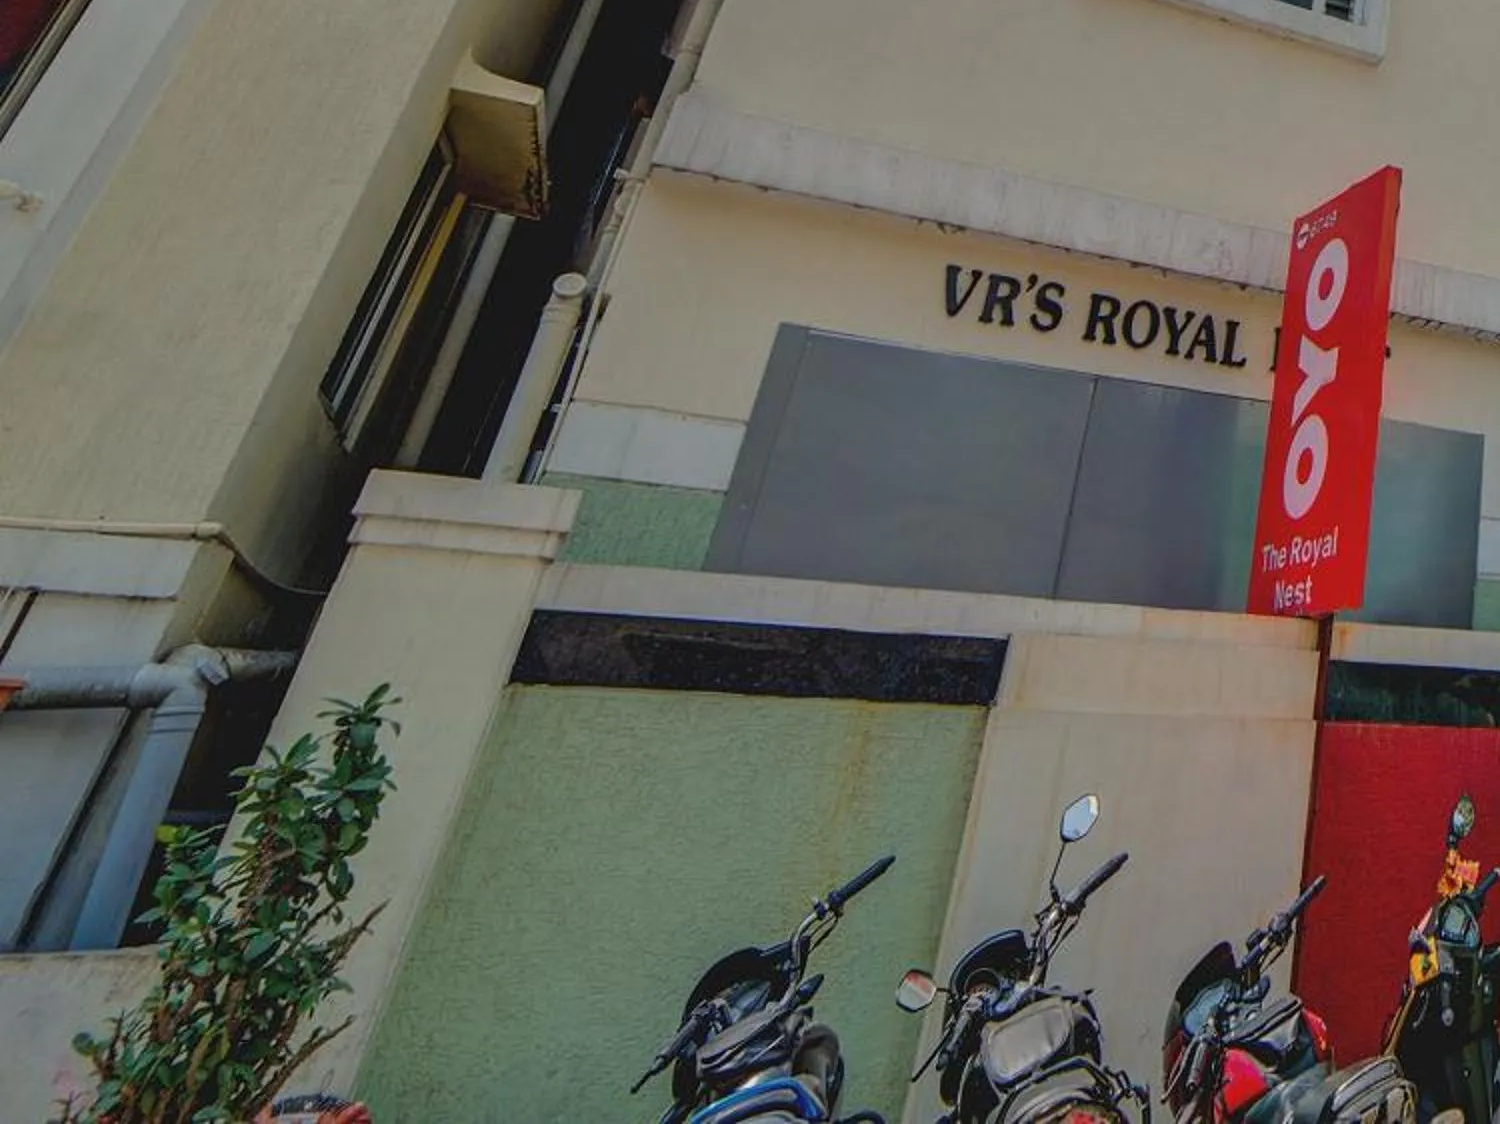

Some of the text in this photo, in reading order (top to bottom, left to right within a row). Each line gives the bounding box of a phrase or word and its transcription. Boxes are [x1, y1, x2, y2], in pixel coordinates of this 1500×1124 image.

[945, 264, 1066, 333] VR'S
[1081, 292, 1248, 368] ROYAL
[1282, 237, 1349, 520] OYO
[1262, 524, 1340, 573] The Royal
[1273, 574, 1313, 614] Nest
